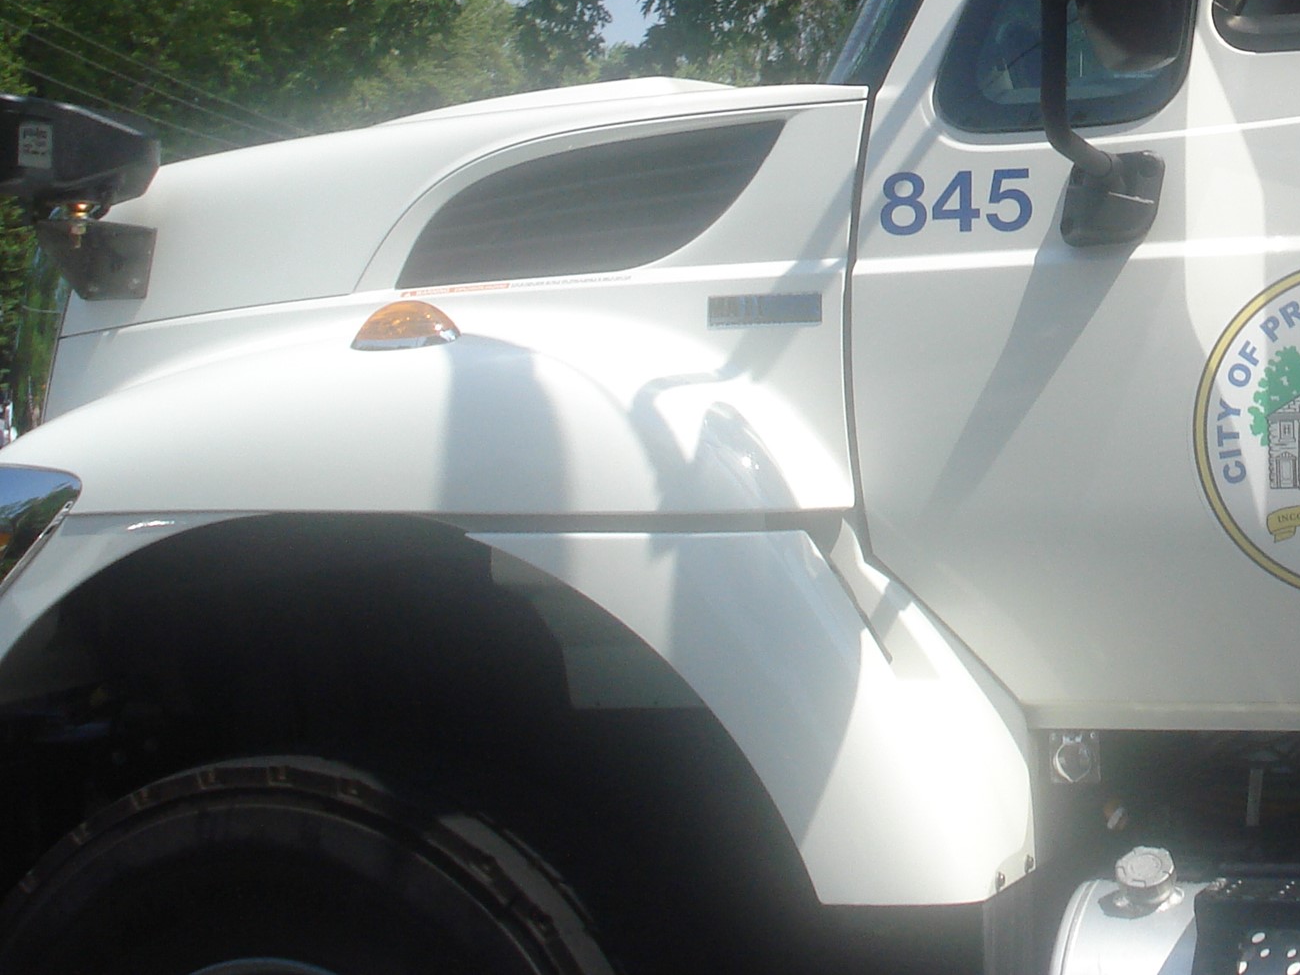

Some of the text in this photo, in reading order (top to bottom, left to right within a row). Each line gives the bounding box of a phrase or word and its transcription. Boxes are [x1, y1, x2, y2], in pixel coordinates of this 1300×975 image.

[879, 167, 1033, 236] 845
[1228, 341, 1261, 388] OF
[1217, 397, 1247, 485] CITY
